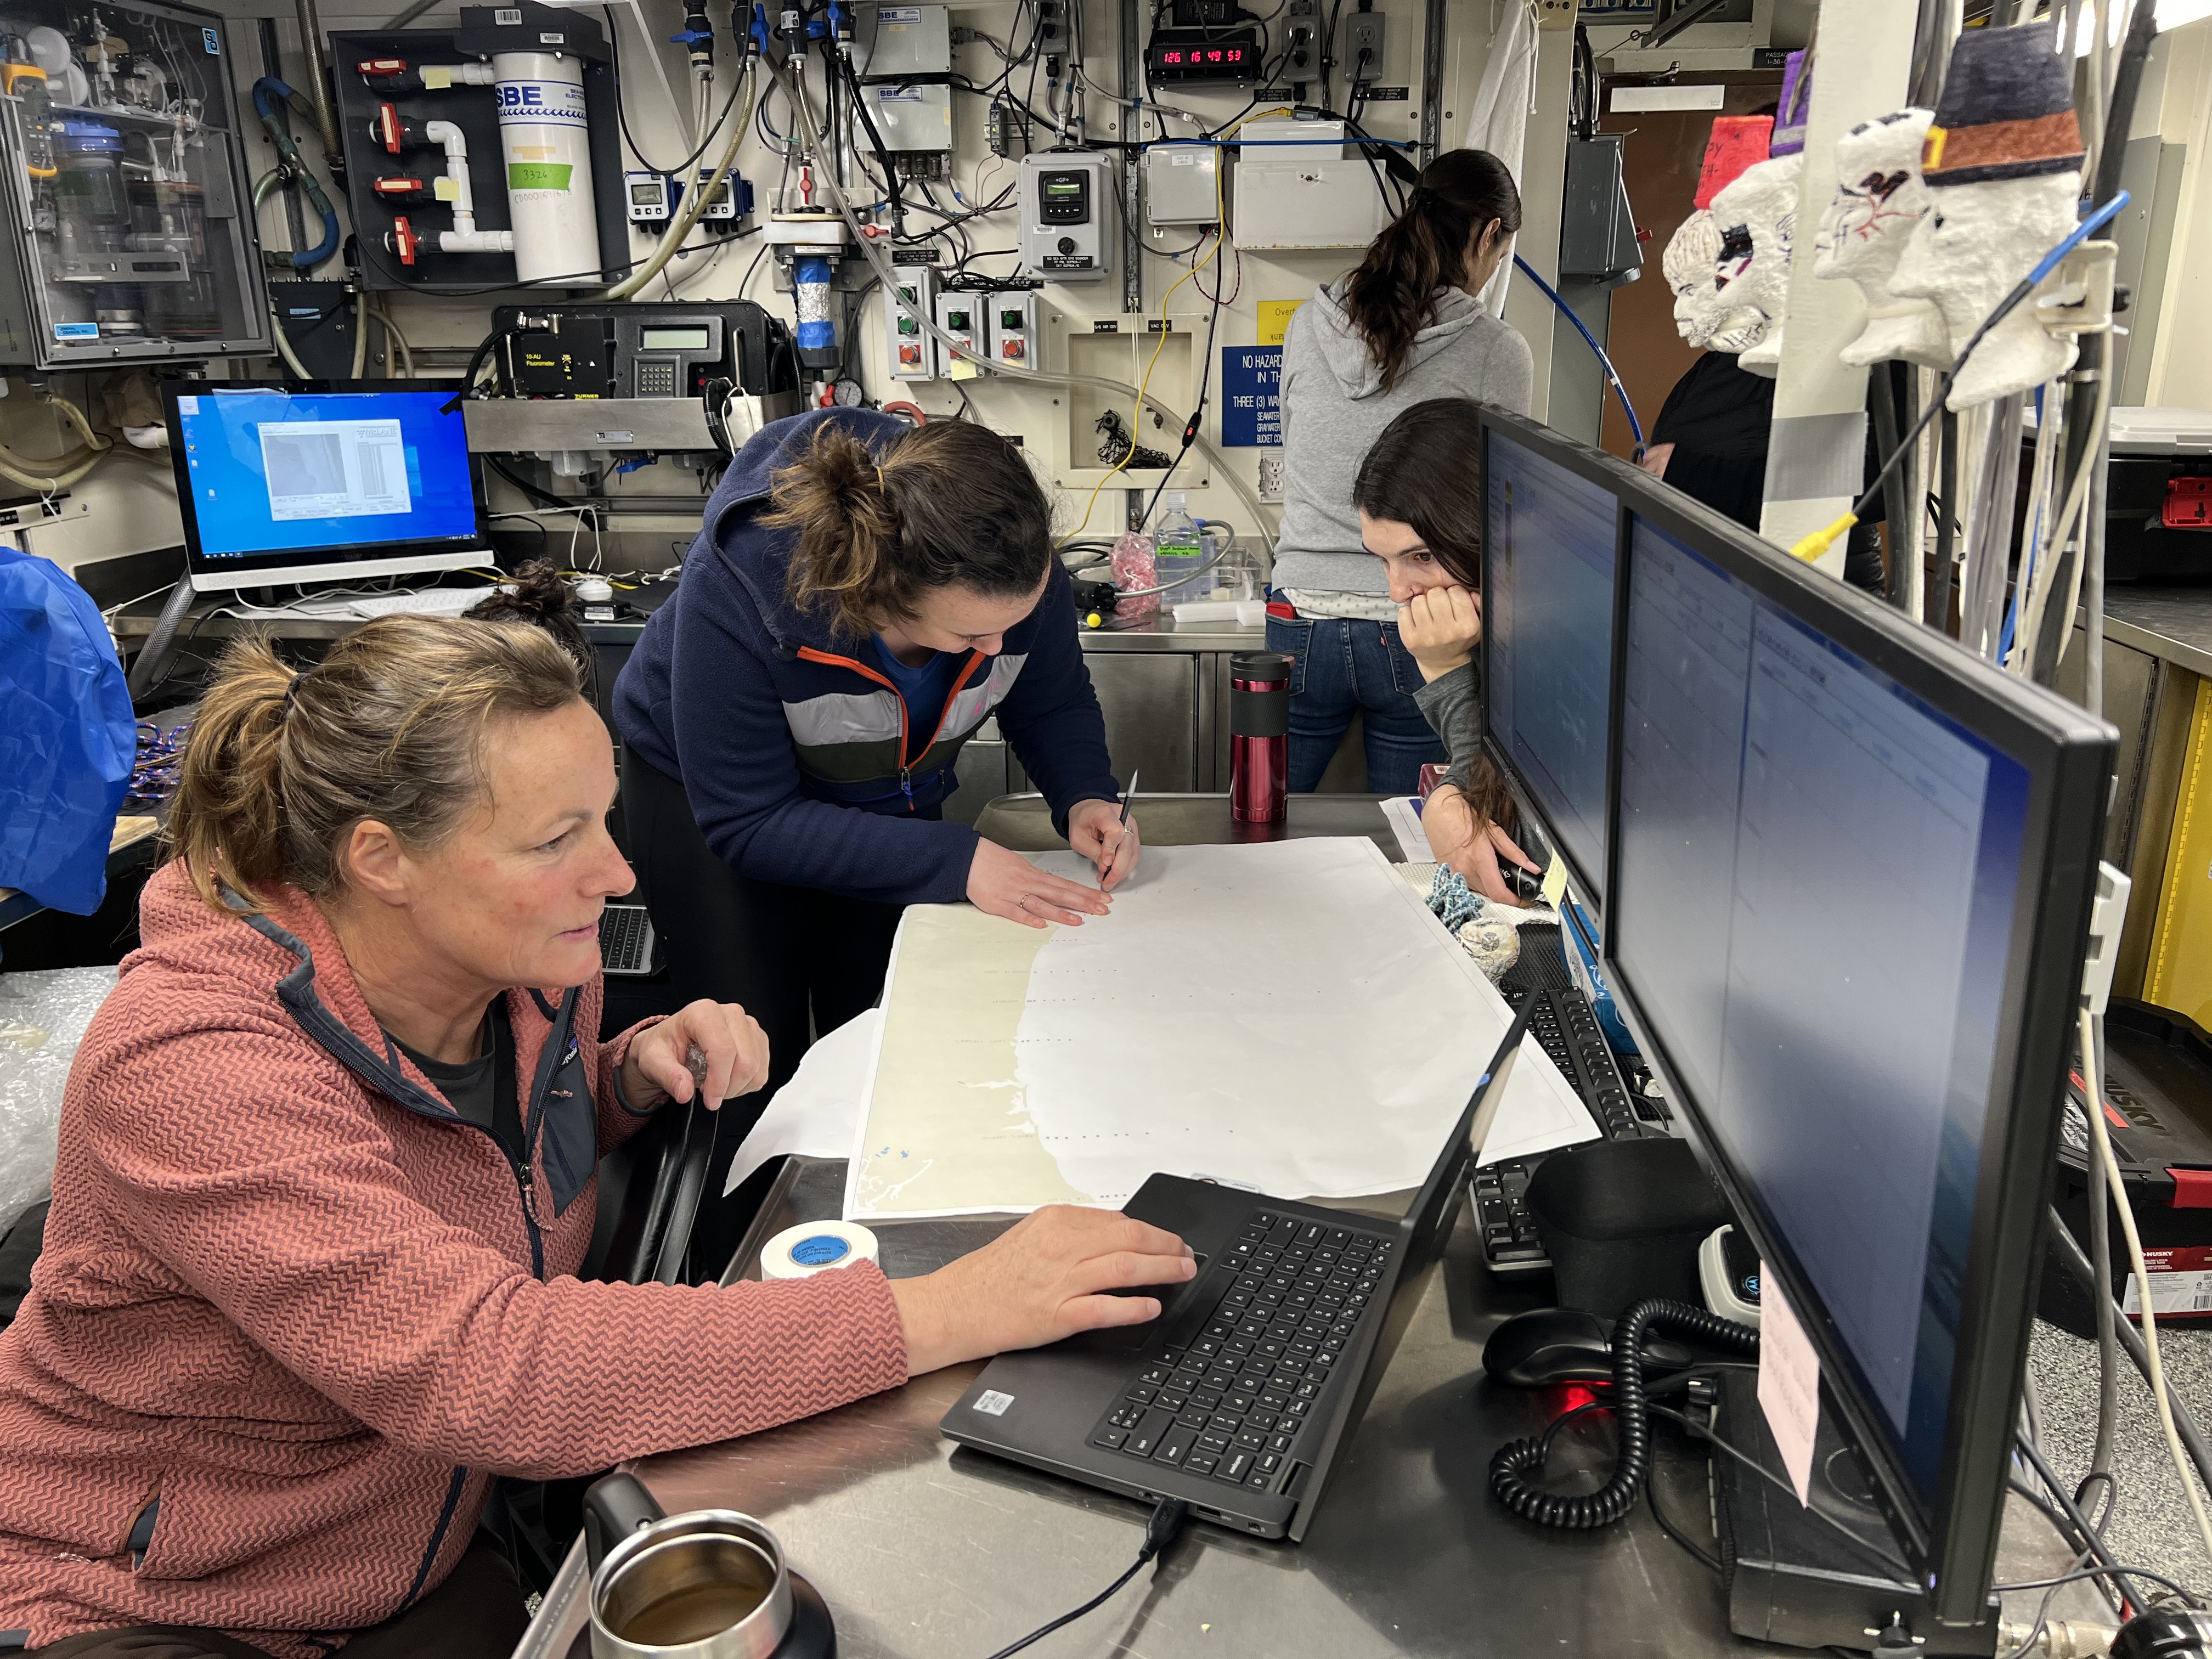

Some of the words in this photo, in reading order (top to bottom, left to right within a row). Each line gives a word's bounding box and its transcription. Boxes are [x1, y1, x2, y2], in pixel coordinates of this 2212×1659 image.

[1165, 52, 1181, 63] 126
[1191, 51, 1200, 62] 16
[1208, 50, 1221, 61] 49
[1227, 50, 1241, 61] 53
[496, 86, 543, 108] SBE
[523, 169, 548, 180] 3326
[1243, 356, 1254, 368] NO
[1257, 371, 1267, 383] IN
[1233, 396, 1254, 408] THREE
[1256, 395, 1266, 410] (3)
[1257, 434, 1273, 443] BUCKET
